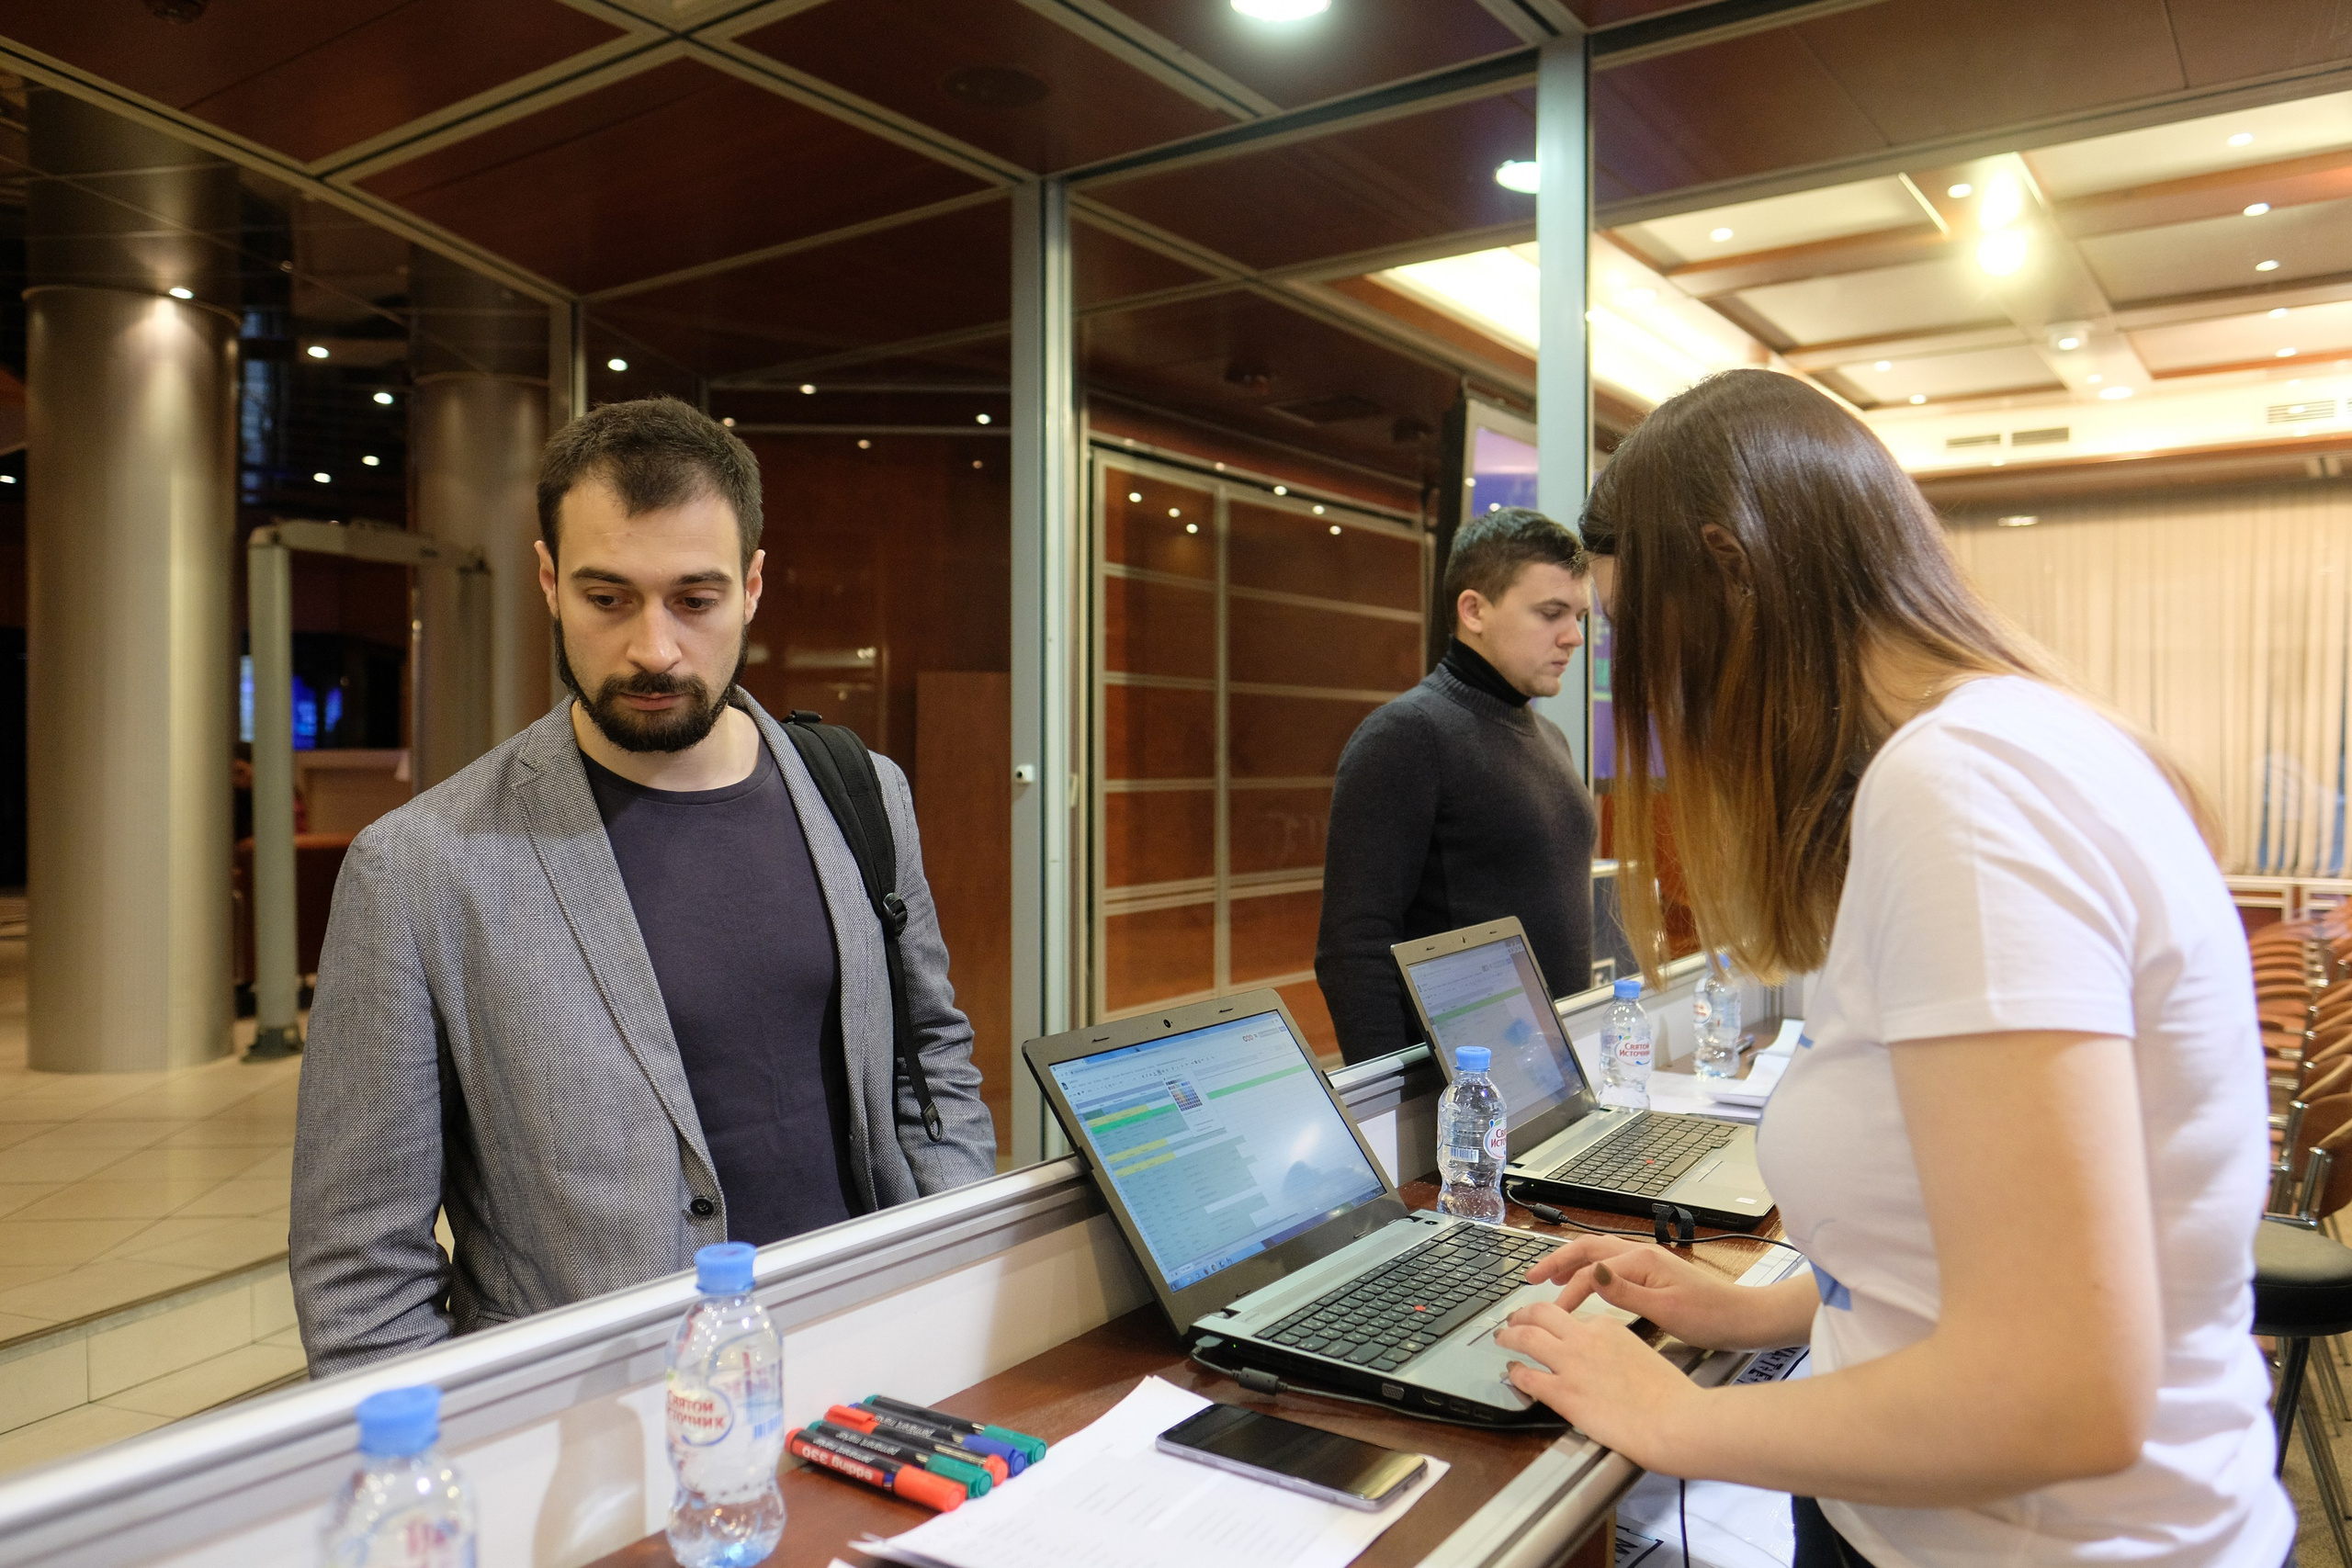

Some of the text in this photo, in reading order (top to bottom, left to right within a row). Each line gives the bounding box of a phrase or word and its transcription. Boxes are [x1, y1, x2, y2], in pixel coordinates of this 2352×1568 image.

[895, 1422, 935, 1438] permanent
[813, 1438, 875, 1463] permanent marker
[835, 1431, 900, 1455] permanent marker
[802, 1446, 873, 1481] edding 330
